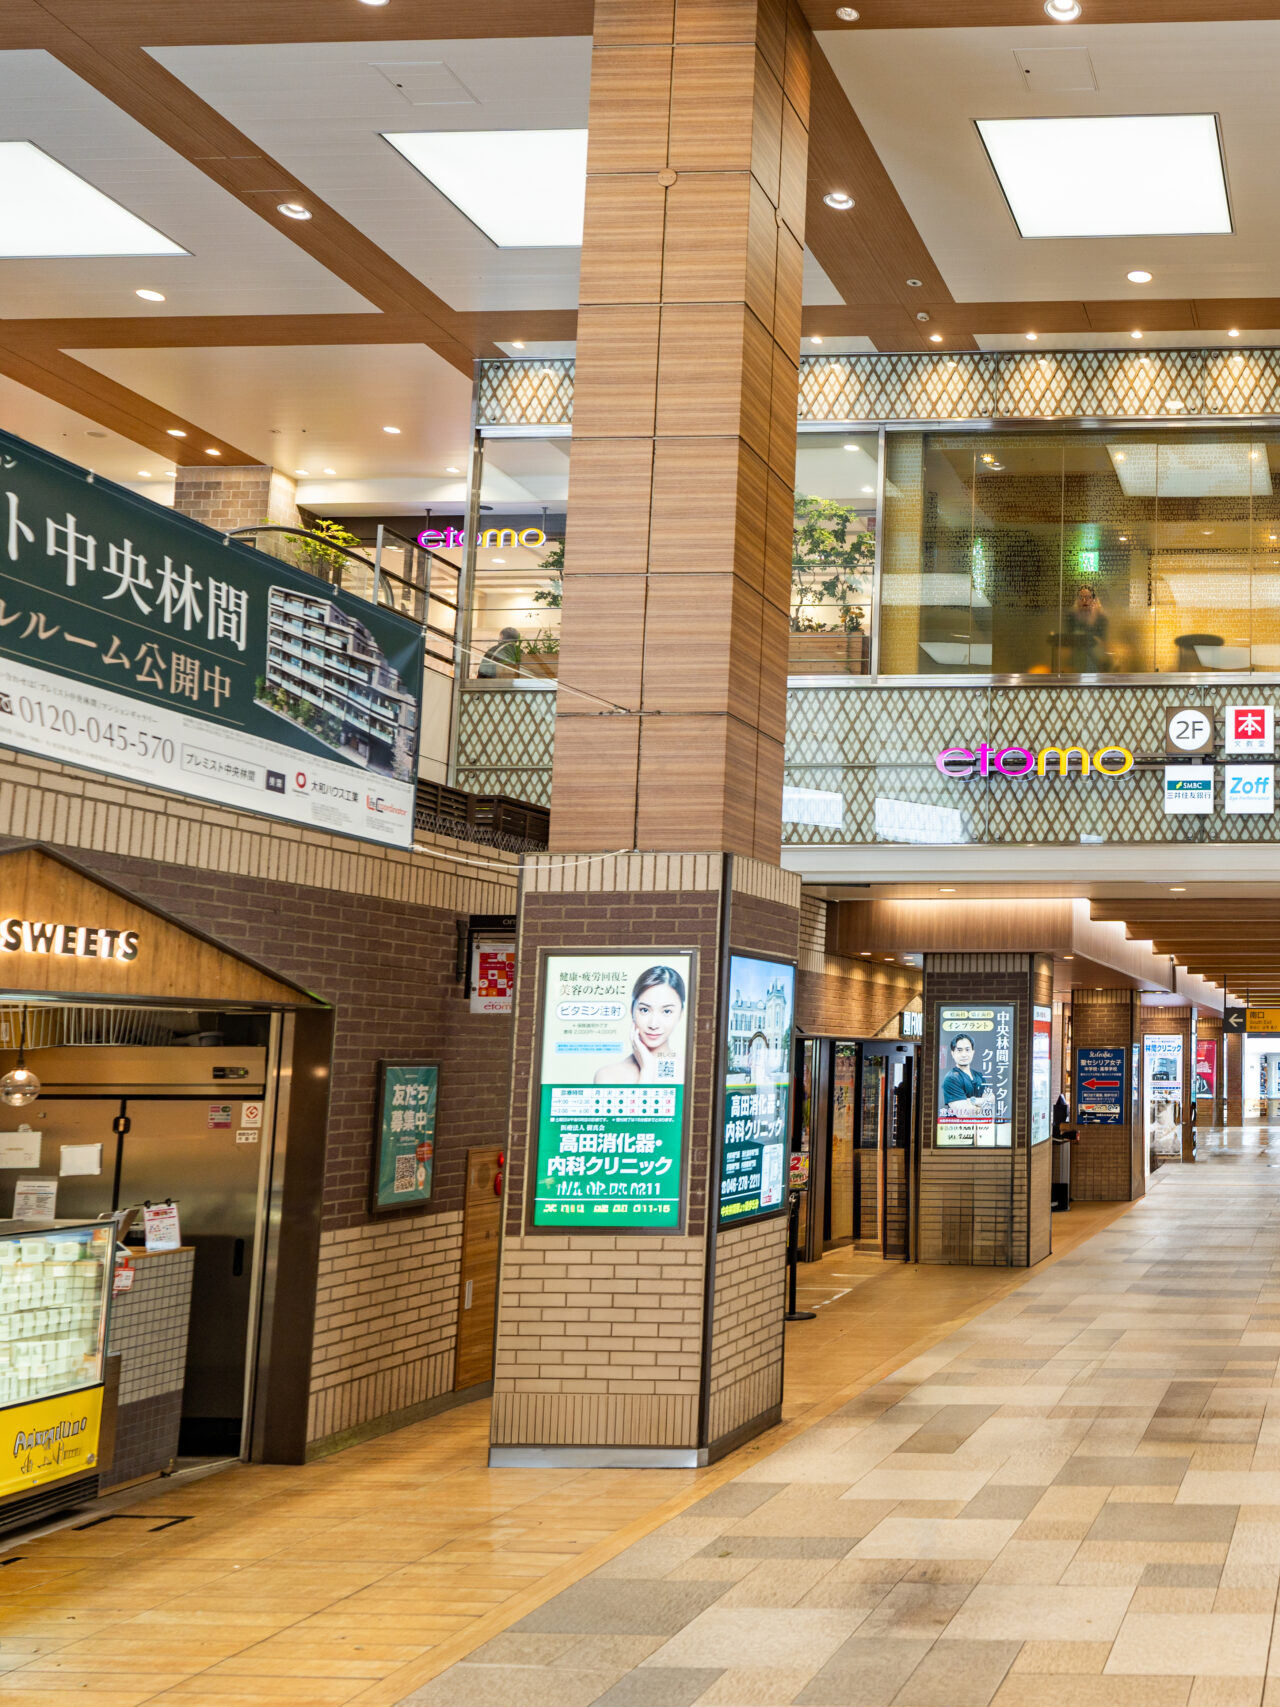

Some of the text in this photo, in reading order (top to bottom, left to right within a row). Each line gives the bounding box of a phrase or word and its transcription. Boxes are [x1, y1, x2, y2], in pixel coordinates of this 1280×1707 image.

[6, 491, 249, 651] ト中央林間
[19, 696, 175, 764] 0120-045-570
[1175, 720, 1204, 740] 2F
[1238, 713, 1262, 736] 本
[935, 742, 1135, 779] etomo
[311, 780, 359, 803] 大和ハウス工業
[1167, 792, 1211, 800] 三井住友銀行
[1183, 782, 1203, 790] SMBC
[1229, 777, 1270, 795] Zoff
[3, 919, 140, 961] SWEETS
[560, 972, 628, 982] 健康・疲労回復と
[560, 985, 626, 996] 美容のために
[484, 1002, 513, 1011] etom
[560, 1005, 621, 1017] ビタミン注射
[948, 1021, 988, 1030] インプラント
[1145, 1044, 1182, 1053] 林間クリニック
[996, 1011, 1010, 1116] 中央林間デンタル
[392, 1084, 429, 1106] 友だち
[390, 1110, 427, 1132] 募集中
[725, 1117, 784, 1144] 内科クリニック
[547, 1156, 673, 1176] 内科クリニック
